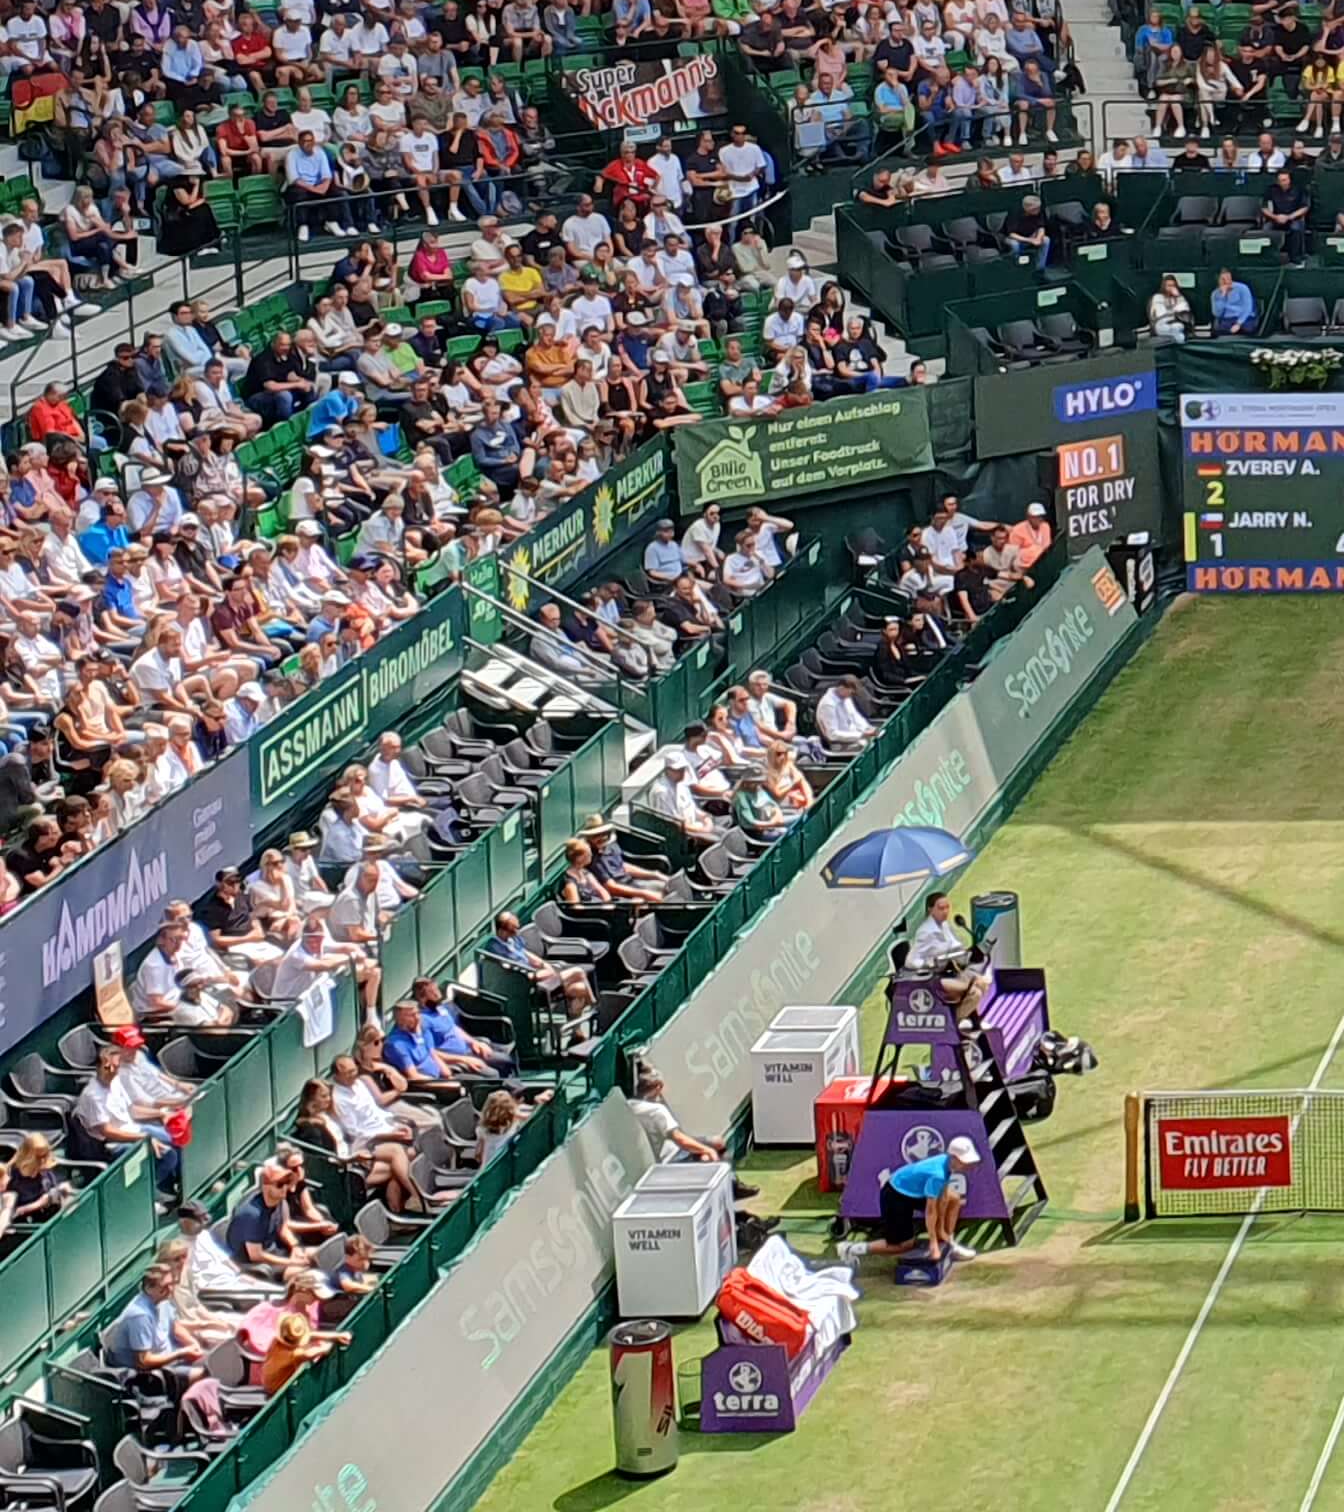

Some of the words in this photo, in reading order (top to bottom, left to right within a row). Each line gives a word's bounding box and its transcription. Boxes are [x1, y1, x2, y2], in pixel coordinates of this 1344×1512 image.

[577, 62, 636, 93] Super
[768, 421, 793, 435] Nur
[835, 401, 901, 424] Aufschlag
[770, 455, 811, 471] Unser
[813, 440, 881, 463] Foodtruck
[1064, 448, 1104, 479] NO.
[1108, 443, 1119, 472] 1
[1227, 460, 1298, 476] ZVEREV
[1301, 460, 1320, 475] A.
[616, 449, 664, 504] MERKUR
[771, 475, 795, 489] auf
[797, 471, 826, 485] dem
[1067, 485, 1099, 511] FOR
[1104, 477, 1135, 504] DRY
[1207, 480, 1225, 505] 2
[1228, 512, 1289, 528] JARRY
[1293, 512, 1312, 527] N.
[532, 508, 585, 569] MERKUR
[1210, 533, 1223, 557] 1
[1004, 604, 1094, 719] Samsonite
[267, 687, 360, 788] ASSMANN
[369, 619, 454, 708] BÜROMÖBEL
[896, 1011, 946, 1028] terra
[764, 1062, 813, 1073] VITAMIN
[1165, 1130, 1283, 1157] Emirates
[1184, 1157, 1209, 1178] FLY
[1214, 1155, 1267, 1177] BETTER
[628, 1229, 681, 1240] VITAMIN
[629, 1241, 661, 1251] WELL
[713, 1391, 778, 1411] terra
